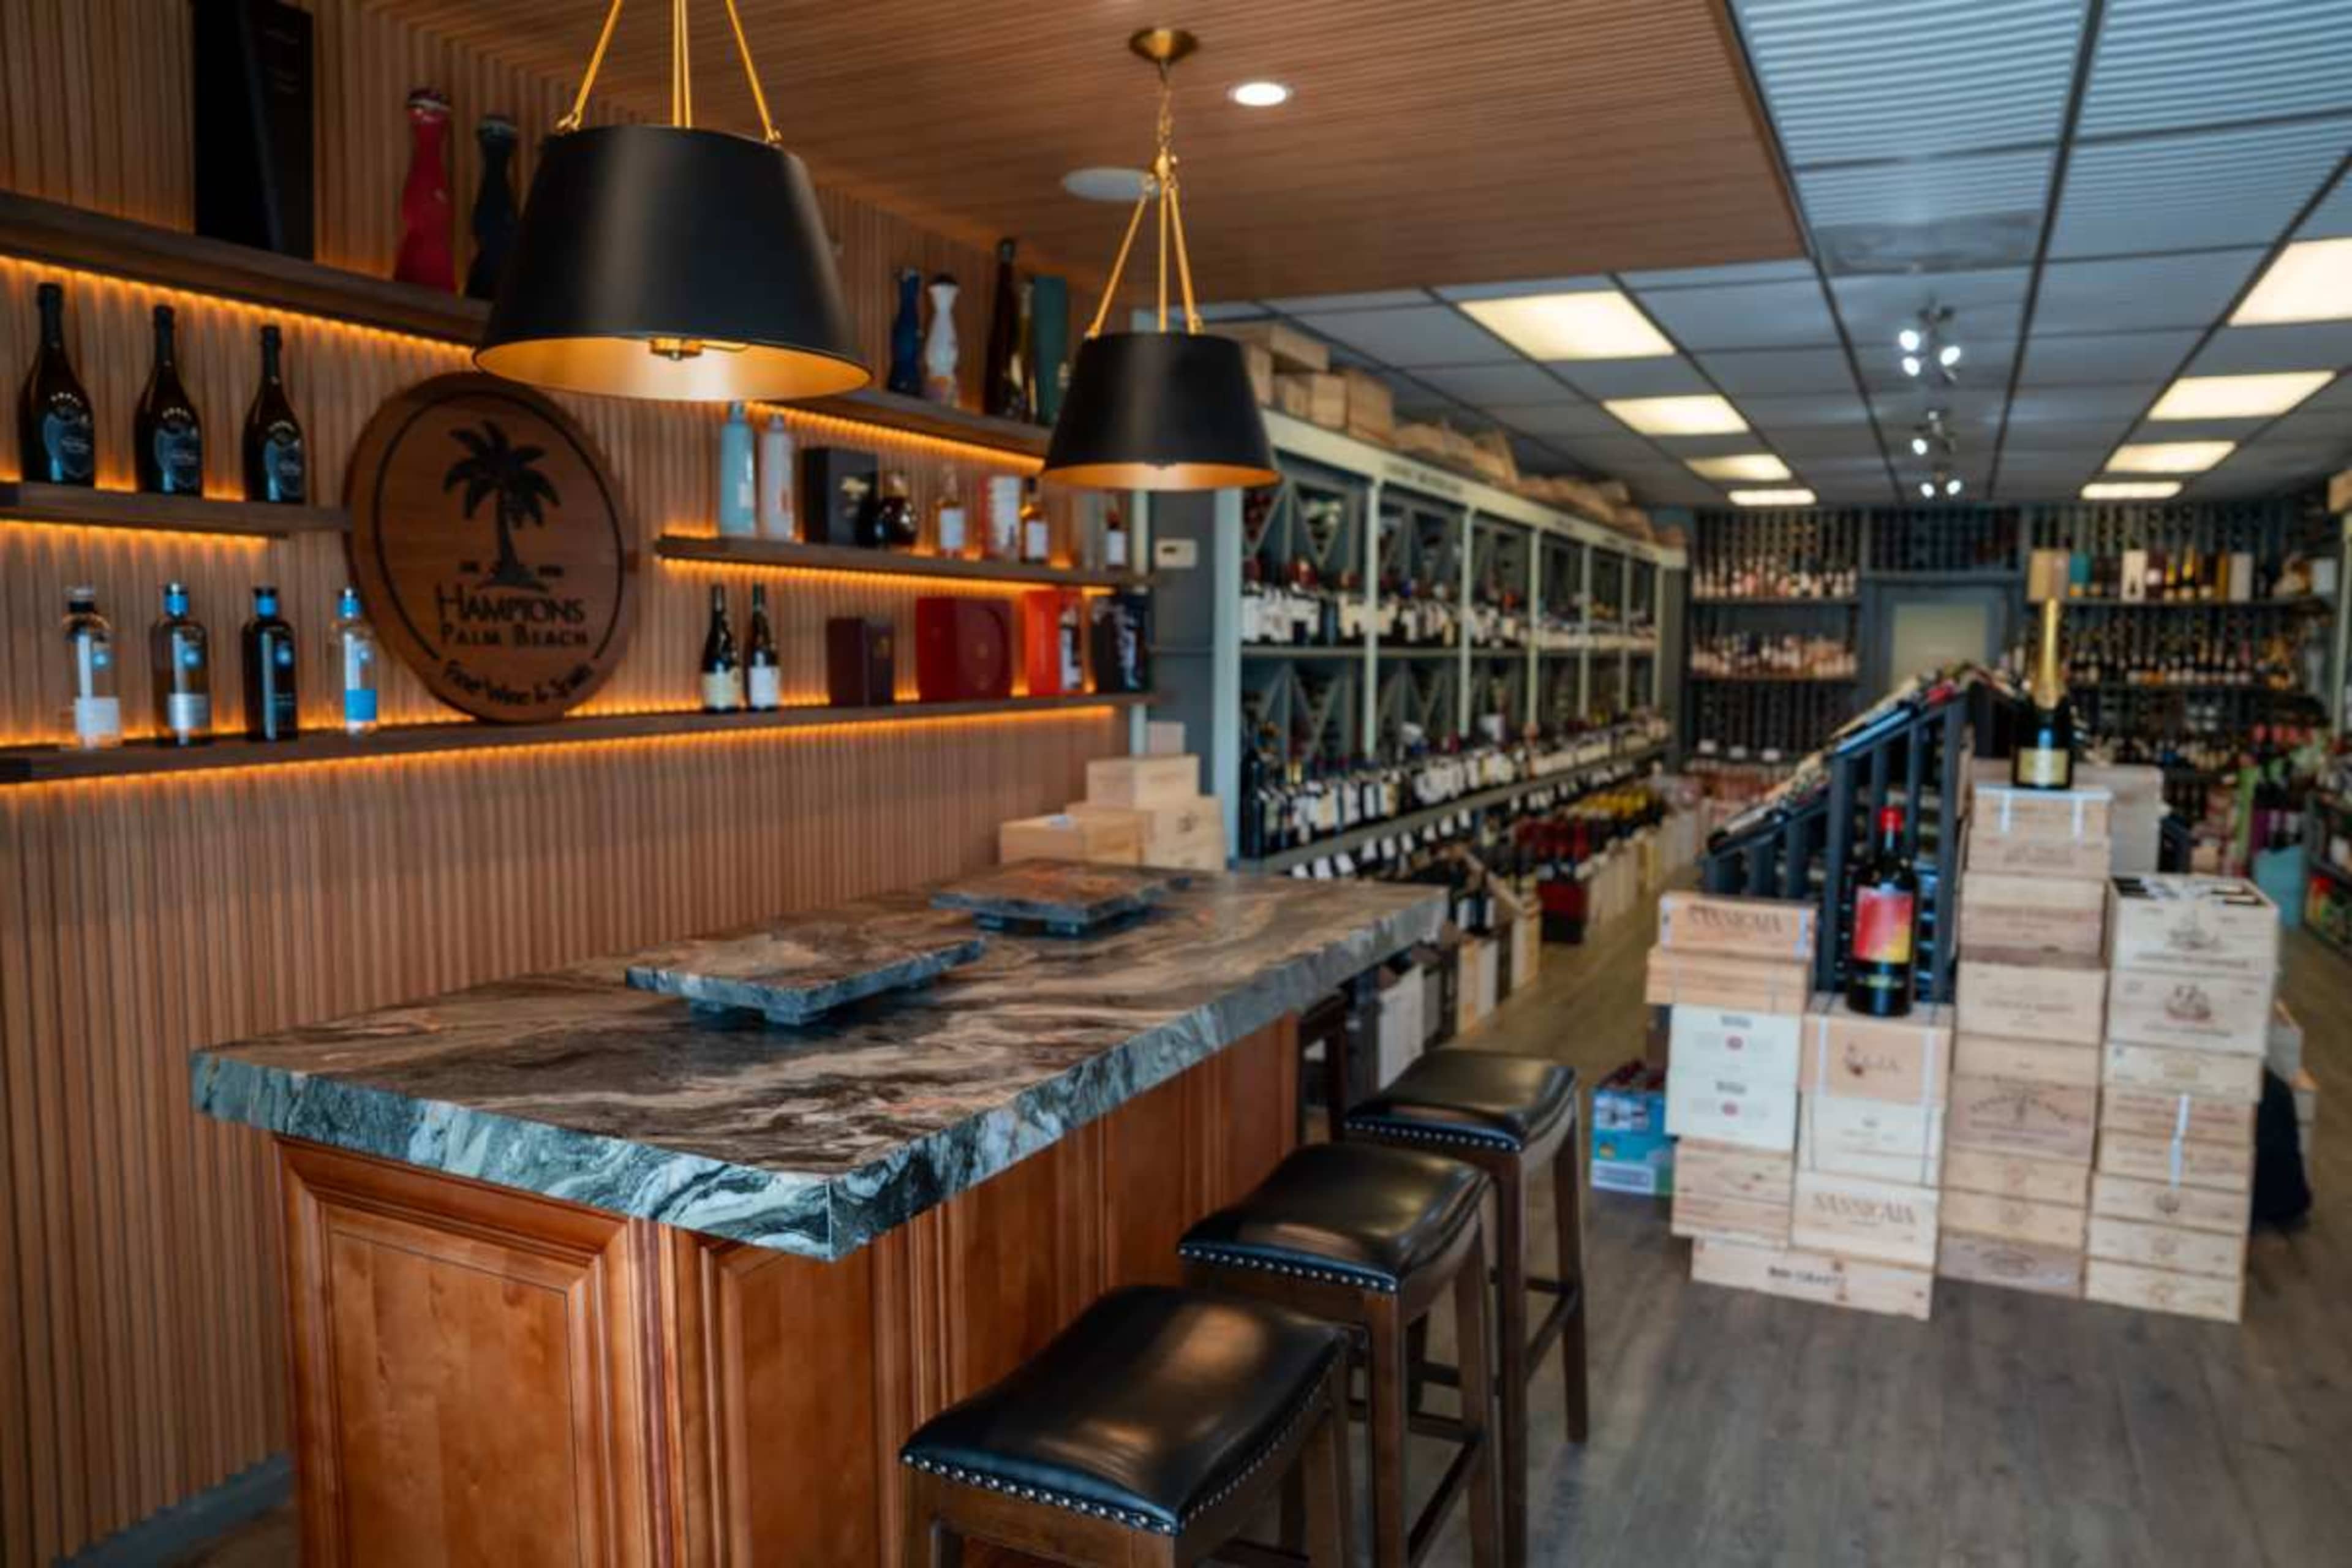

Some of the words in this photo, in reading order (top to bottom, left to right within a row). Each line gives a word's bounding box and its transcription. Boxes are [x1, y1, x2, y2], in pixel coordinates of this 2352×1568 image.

[435, 584, 586, 622] HAMPTONS
[440, 623, 501, 645] PALM
[512, 624, 588, 647] BEACH
